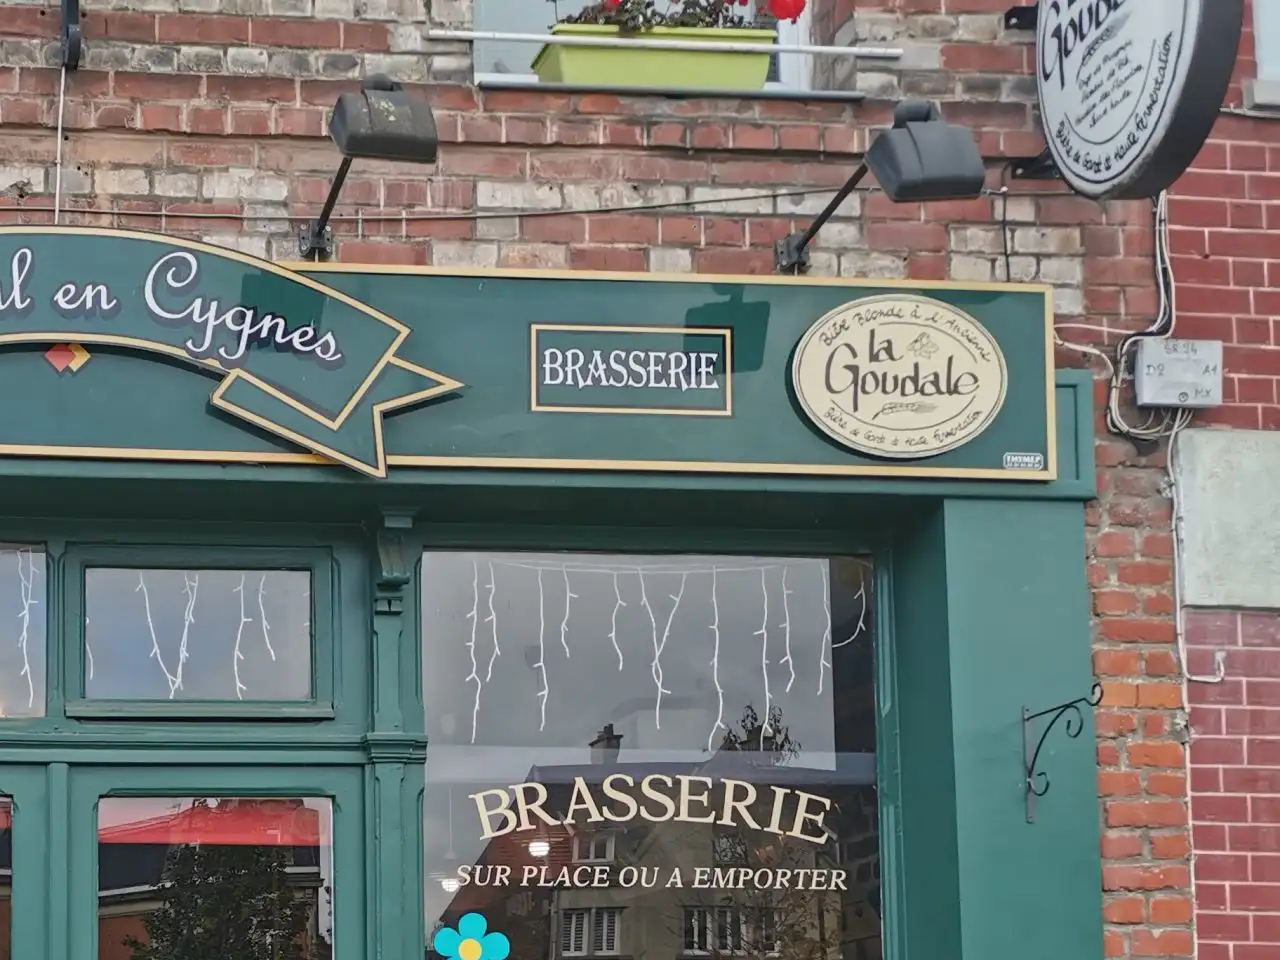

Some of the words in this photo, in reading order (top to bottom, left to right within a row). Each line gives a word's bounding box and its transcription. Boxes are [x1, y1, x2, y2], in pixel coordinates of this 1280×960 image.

[53, 281, 117, 310] en
[144, 252, 343, 361] Cygnes
[820, 318, 850, 347] Bière
[852, 305, 904, 326] Blonde
[910, 305, 920, 319] à
[869, 328, 904, 362] la
[543, 348, 719, 392] BRASSERIE
[825, 343, 979, 412] Goudale
[823, 407, 847, 429] Bière
[468, 774, 832, 845] BRASSERIE
[456, 865, 512, 887] SUR
[520, 866, 610, 888] PLACE
[619, 866, 659, 889] OU
[666, 867, 683, 888] A
[693, 867, 848, 891] EMPORTER
